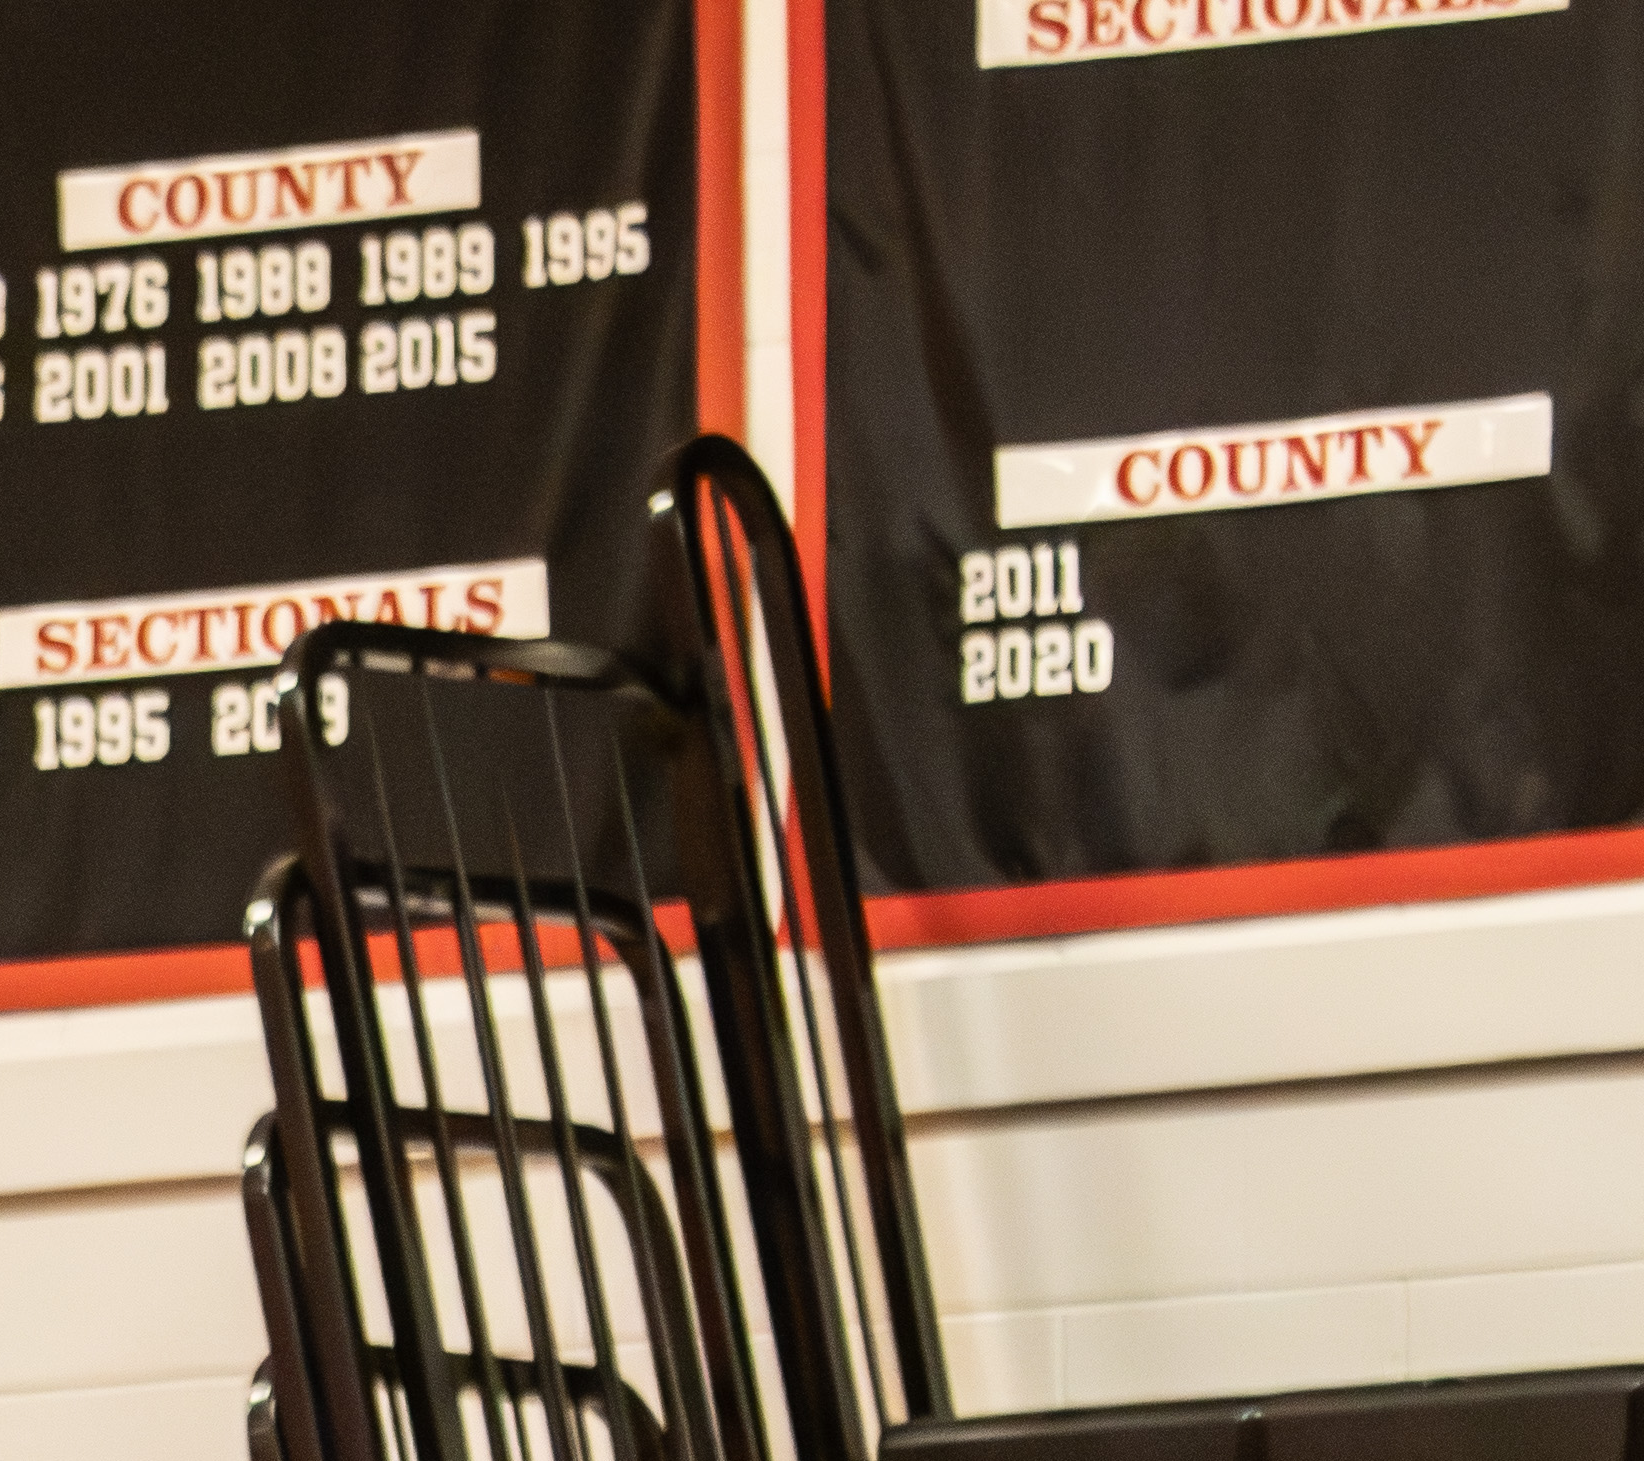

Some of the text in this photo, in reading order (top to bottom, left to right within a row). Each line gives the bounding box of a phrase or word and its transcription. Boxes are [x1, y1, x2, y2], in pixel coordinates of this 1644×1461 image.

[116, 148, 424, 235] COUNTY
[36, 258, 170, 339] 1976
[197, 240, 332, 323] 1988
[360, 223, 495, 306] 1989
[523, 201, 650, 289] 1995
[34, 344, 170, 424] 2001
[197, 327, 347, 410] 2008
[360, 309, 497, 394] 2015
[1115, 419, 1442, 507] COUNTY
[960, 542, 1084, 624] 2011
[961, 618, 1115, 704] 2020
[34, 690, 171, 771] 1995
[210, 672, 350, 757] 209
